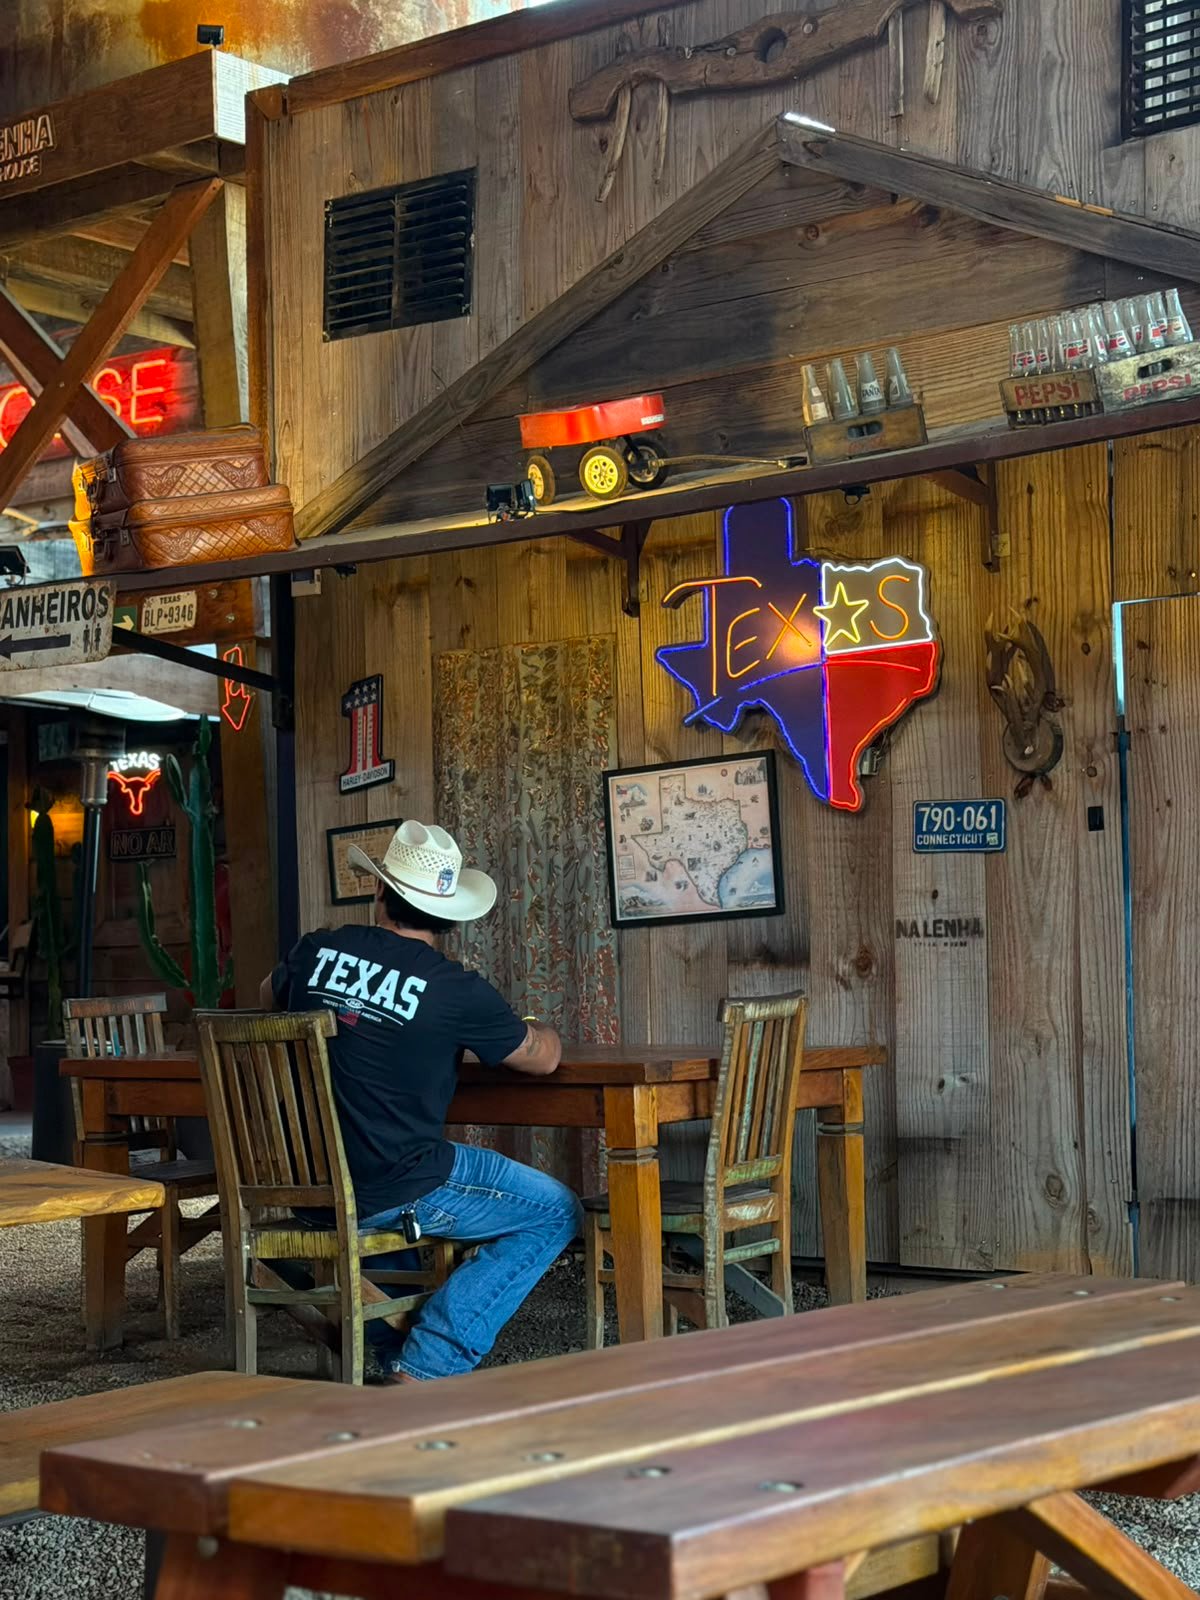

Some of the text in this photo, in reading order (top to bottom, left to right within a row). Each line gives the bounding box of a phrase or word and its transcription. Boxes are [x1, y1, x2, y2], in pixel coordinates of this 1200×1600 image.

[1014, 381, 1080, 407] PEPSI
[0, 586, 110, 630] ANHEIROS
[159, 594, 182, 605] TEXAS
[110, 751, 161, 773] TEXAS
[916, 832, 985, 846] CONNECTICUT
[307, 947, 427, 1021] TEXAS
